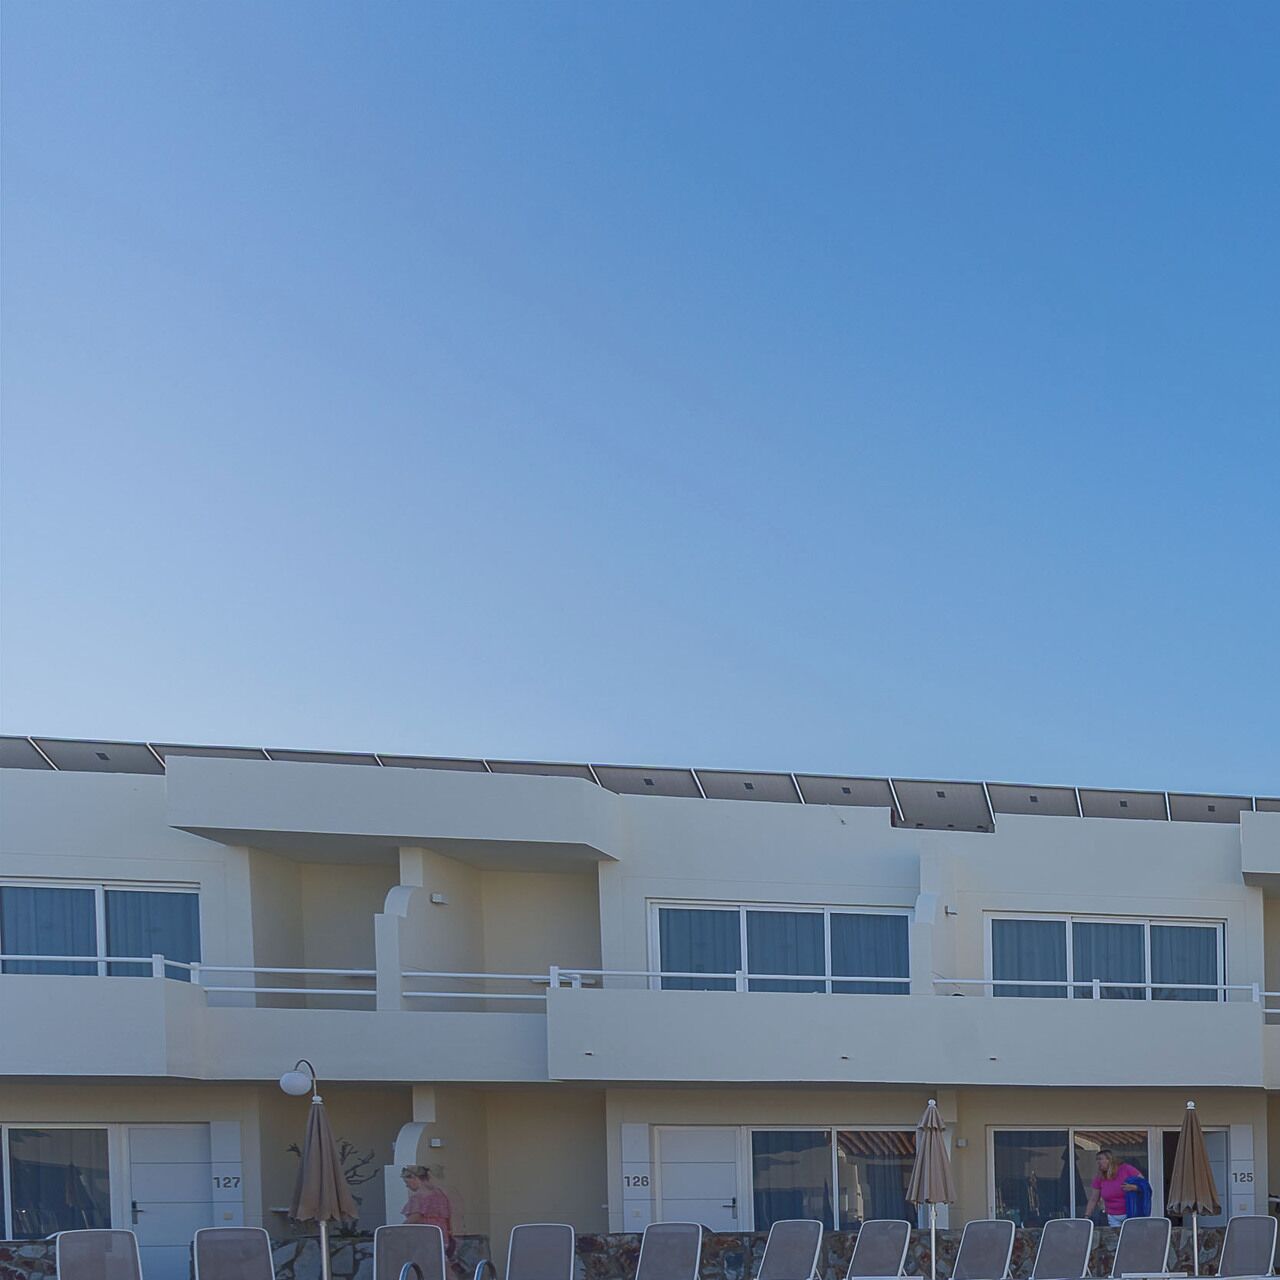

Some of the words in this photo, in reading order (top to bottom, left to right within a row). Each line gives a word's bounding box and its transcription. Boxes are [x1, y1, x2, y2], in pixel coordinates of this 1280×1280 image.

[213, 1176, 240, 1188] 127
[624, 1175, 649, 1187] 126
[1232, 1172, 1253, 1183] 125
